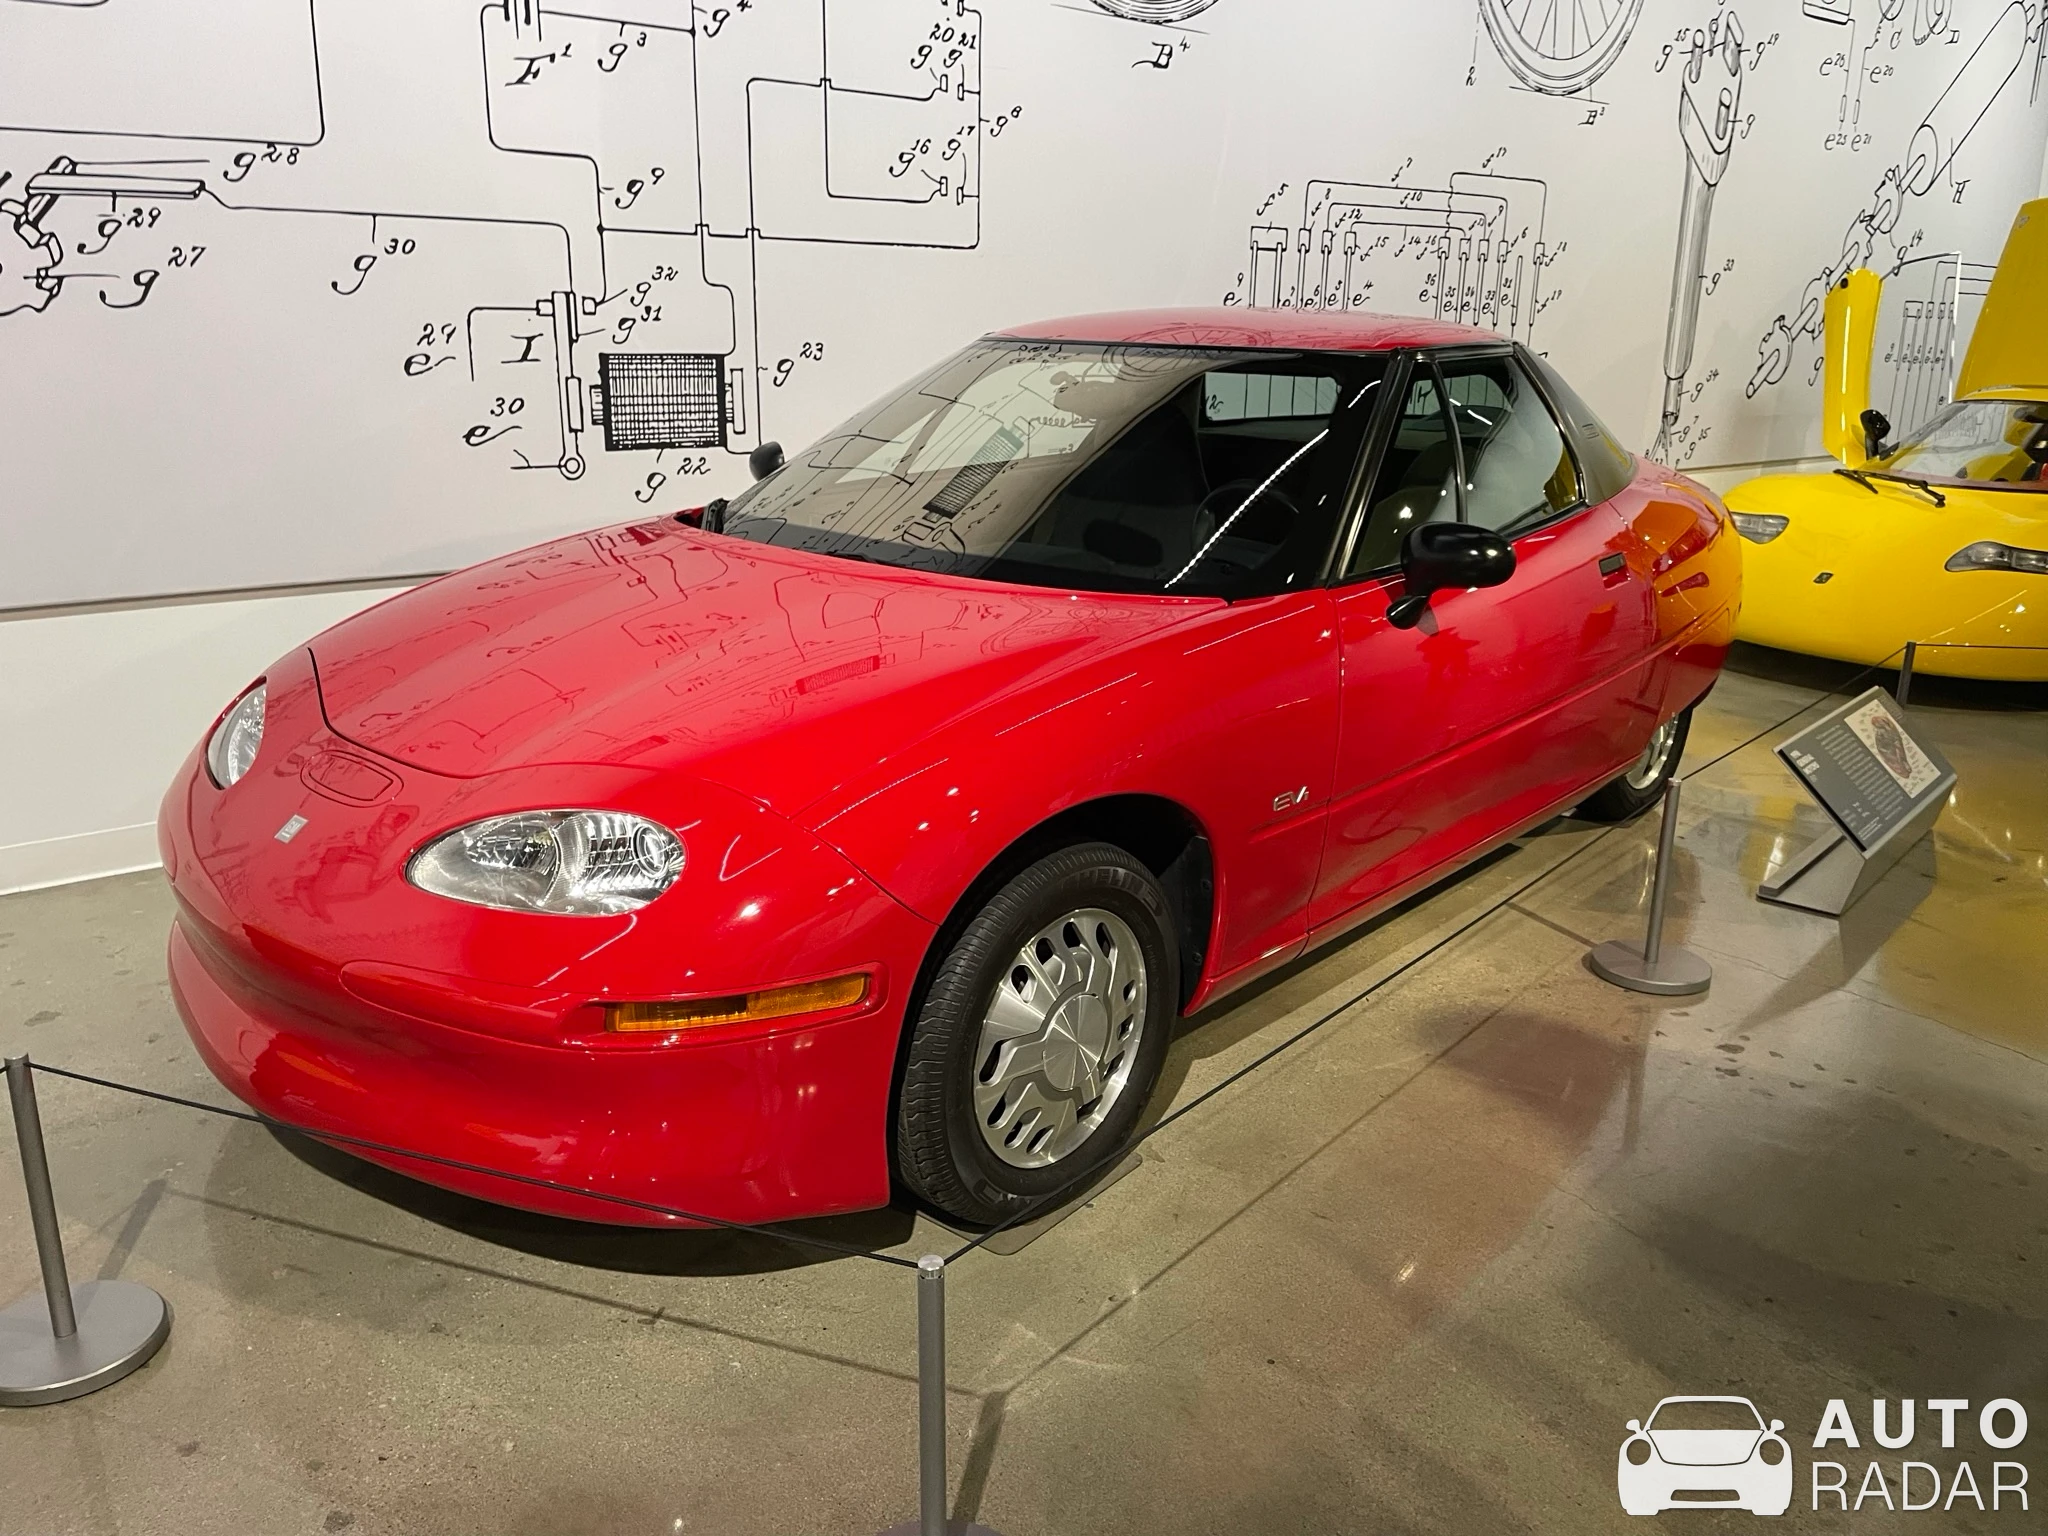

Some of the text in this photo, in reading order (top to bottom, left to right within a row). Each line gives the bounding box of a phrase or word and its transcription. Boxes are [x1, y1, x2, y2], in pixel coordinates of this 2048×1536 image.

[598, 32, 647, 72] g3
[910, 23, 955, 69] g20
[943, 32, 977, 68] g21
[223, 143, 300, 183] g28
[615, 168, 665, 209] g9
[77, 207, 161, 255] g29
[99, 246, 206, 308] g27
[331, 238, 416, 295] g30
[629, 266, 679, 306] g32
[773, 342, 824, 387] g23
[462, 397, 523, 447] e30
[635, 457, 711, 503] g22
[1273, 786, 1309, 811] EV1
